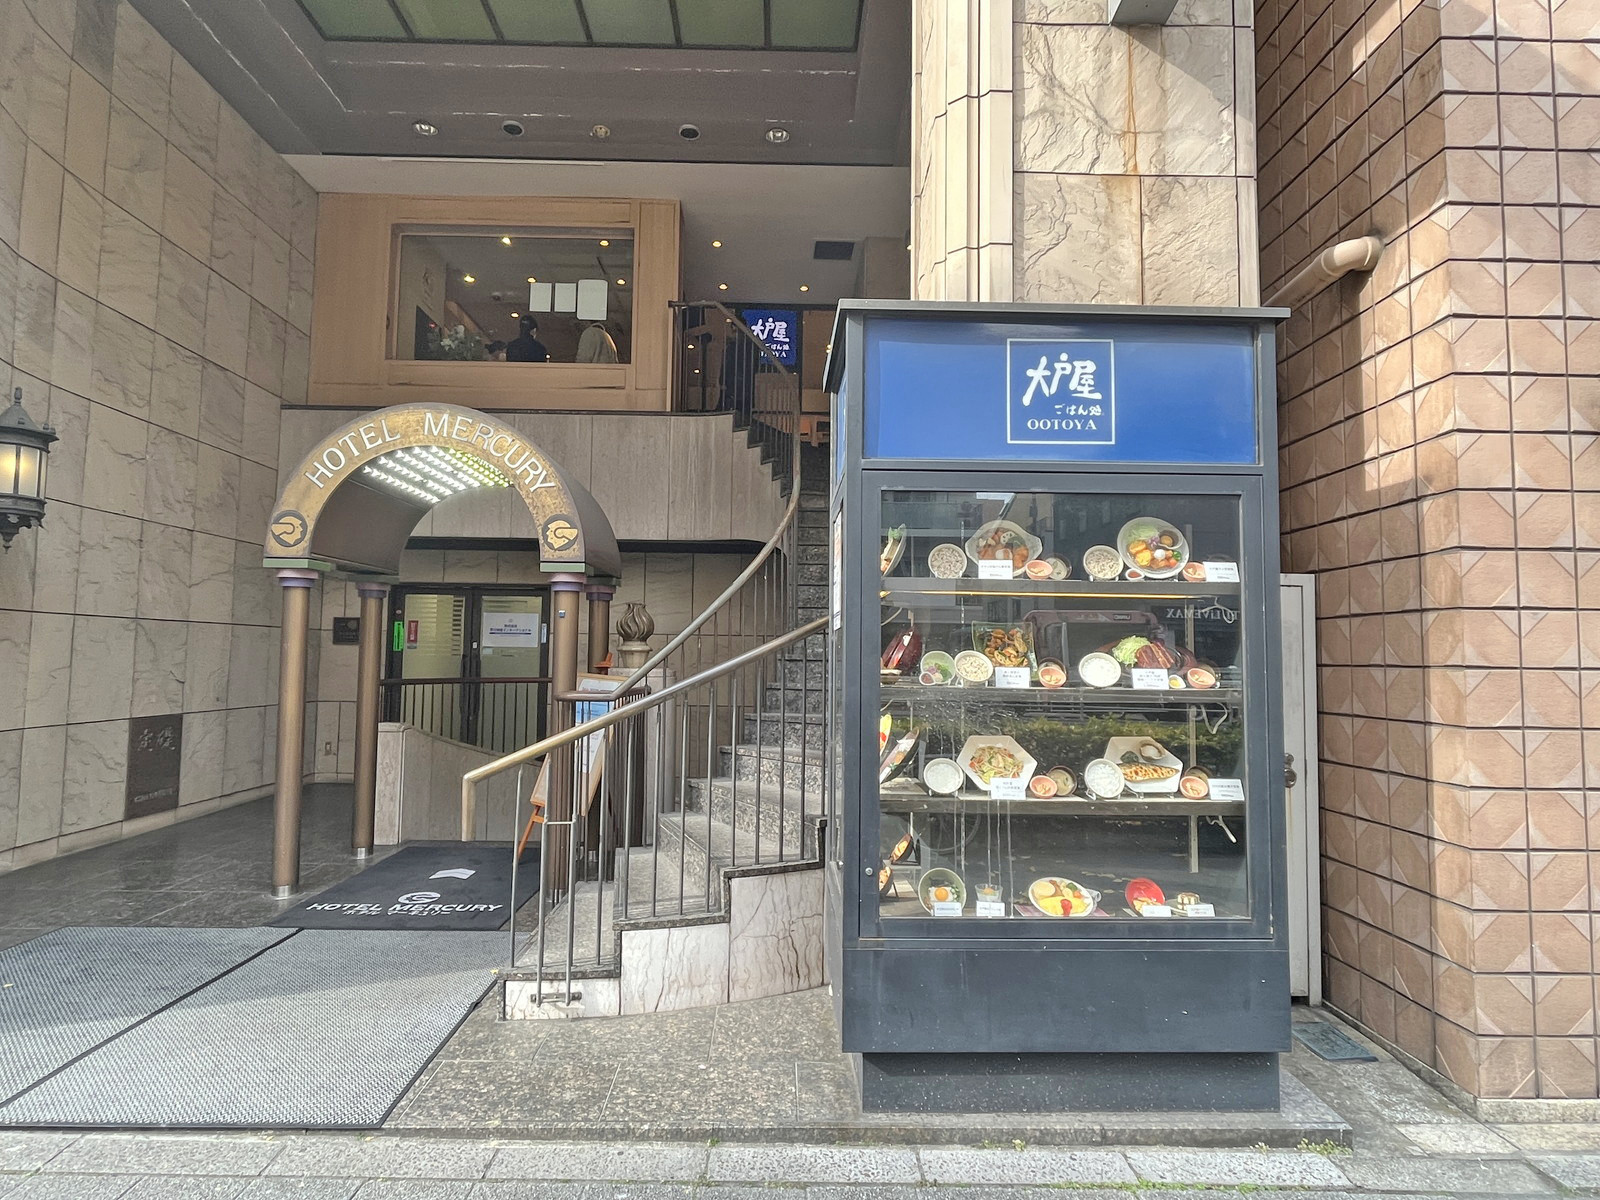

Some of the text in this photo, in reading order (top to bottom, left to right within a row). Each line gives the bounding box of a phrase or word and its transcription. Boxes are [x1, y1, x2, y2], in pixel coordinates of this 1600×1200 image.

[1054, 403, 1103, 417] ごはん処
[1027, 418, 1097, 431] OOTOYA
[304, 412, 556, 494] HOTEL MERCURY
[305, 903, 504, 912] HOTEL MERCURY
